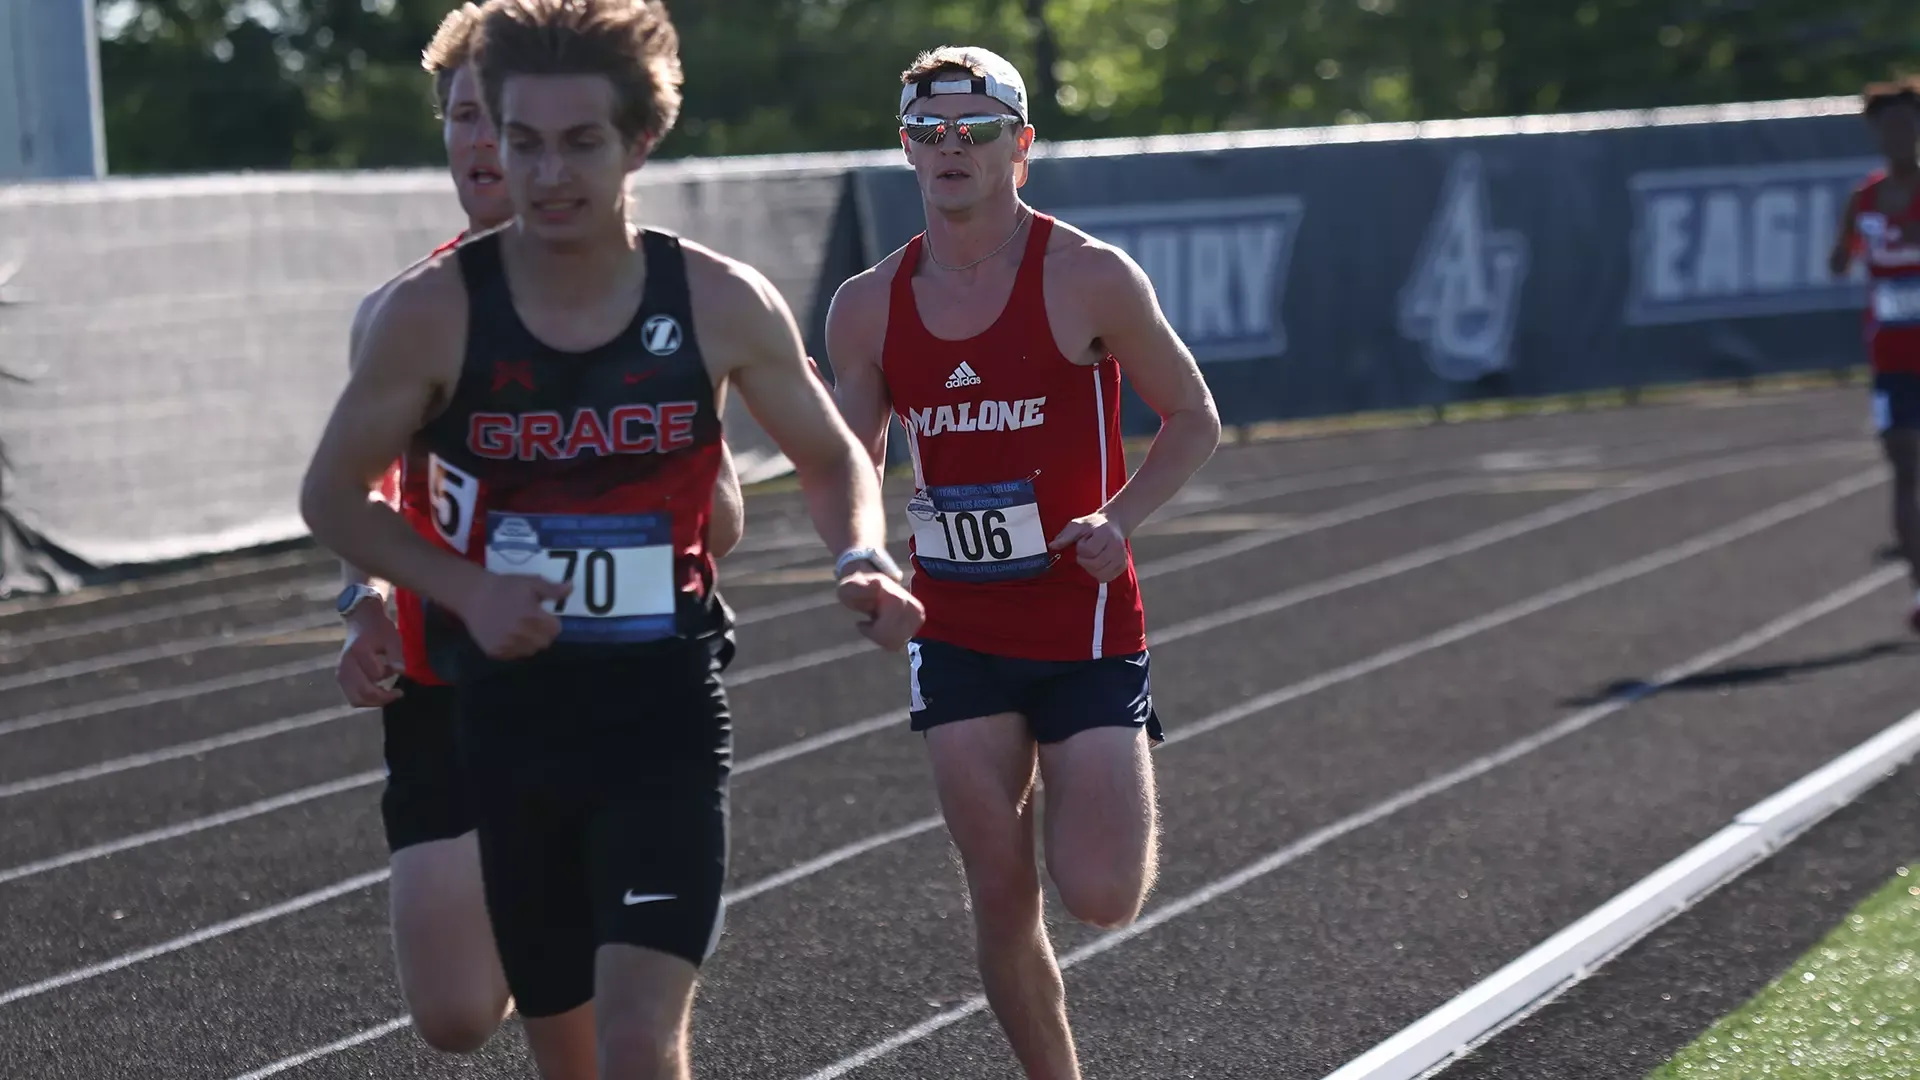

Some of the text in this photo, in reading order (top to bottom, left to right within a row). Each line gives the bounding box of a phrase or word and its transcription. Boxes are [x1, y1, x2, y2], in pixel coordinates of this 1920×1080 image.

[945, 376, 981, 388] adidas
[467, 401, 697, 460] GRACE
[909, 396, 1046, 436] MALONE
[935, 509, 1013, 561] 106
[548, 550, 615, 615] 70
